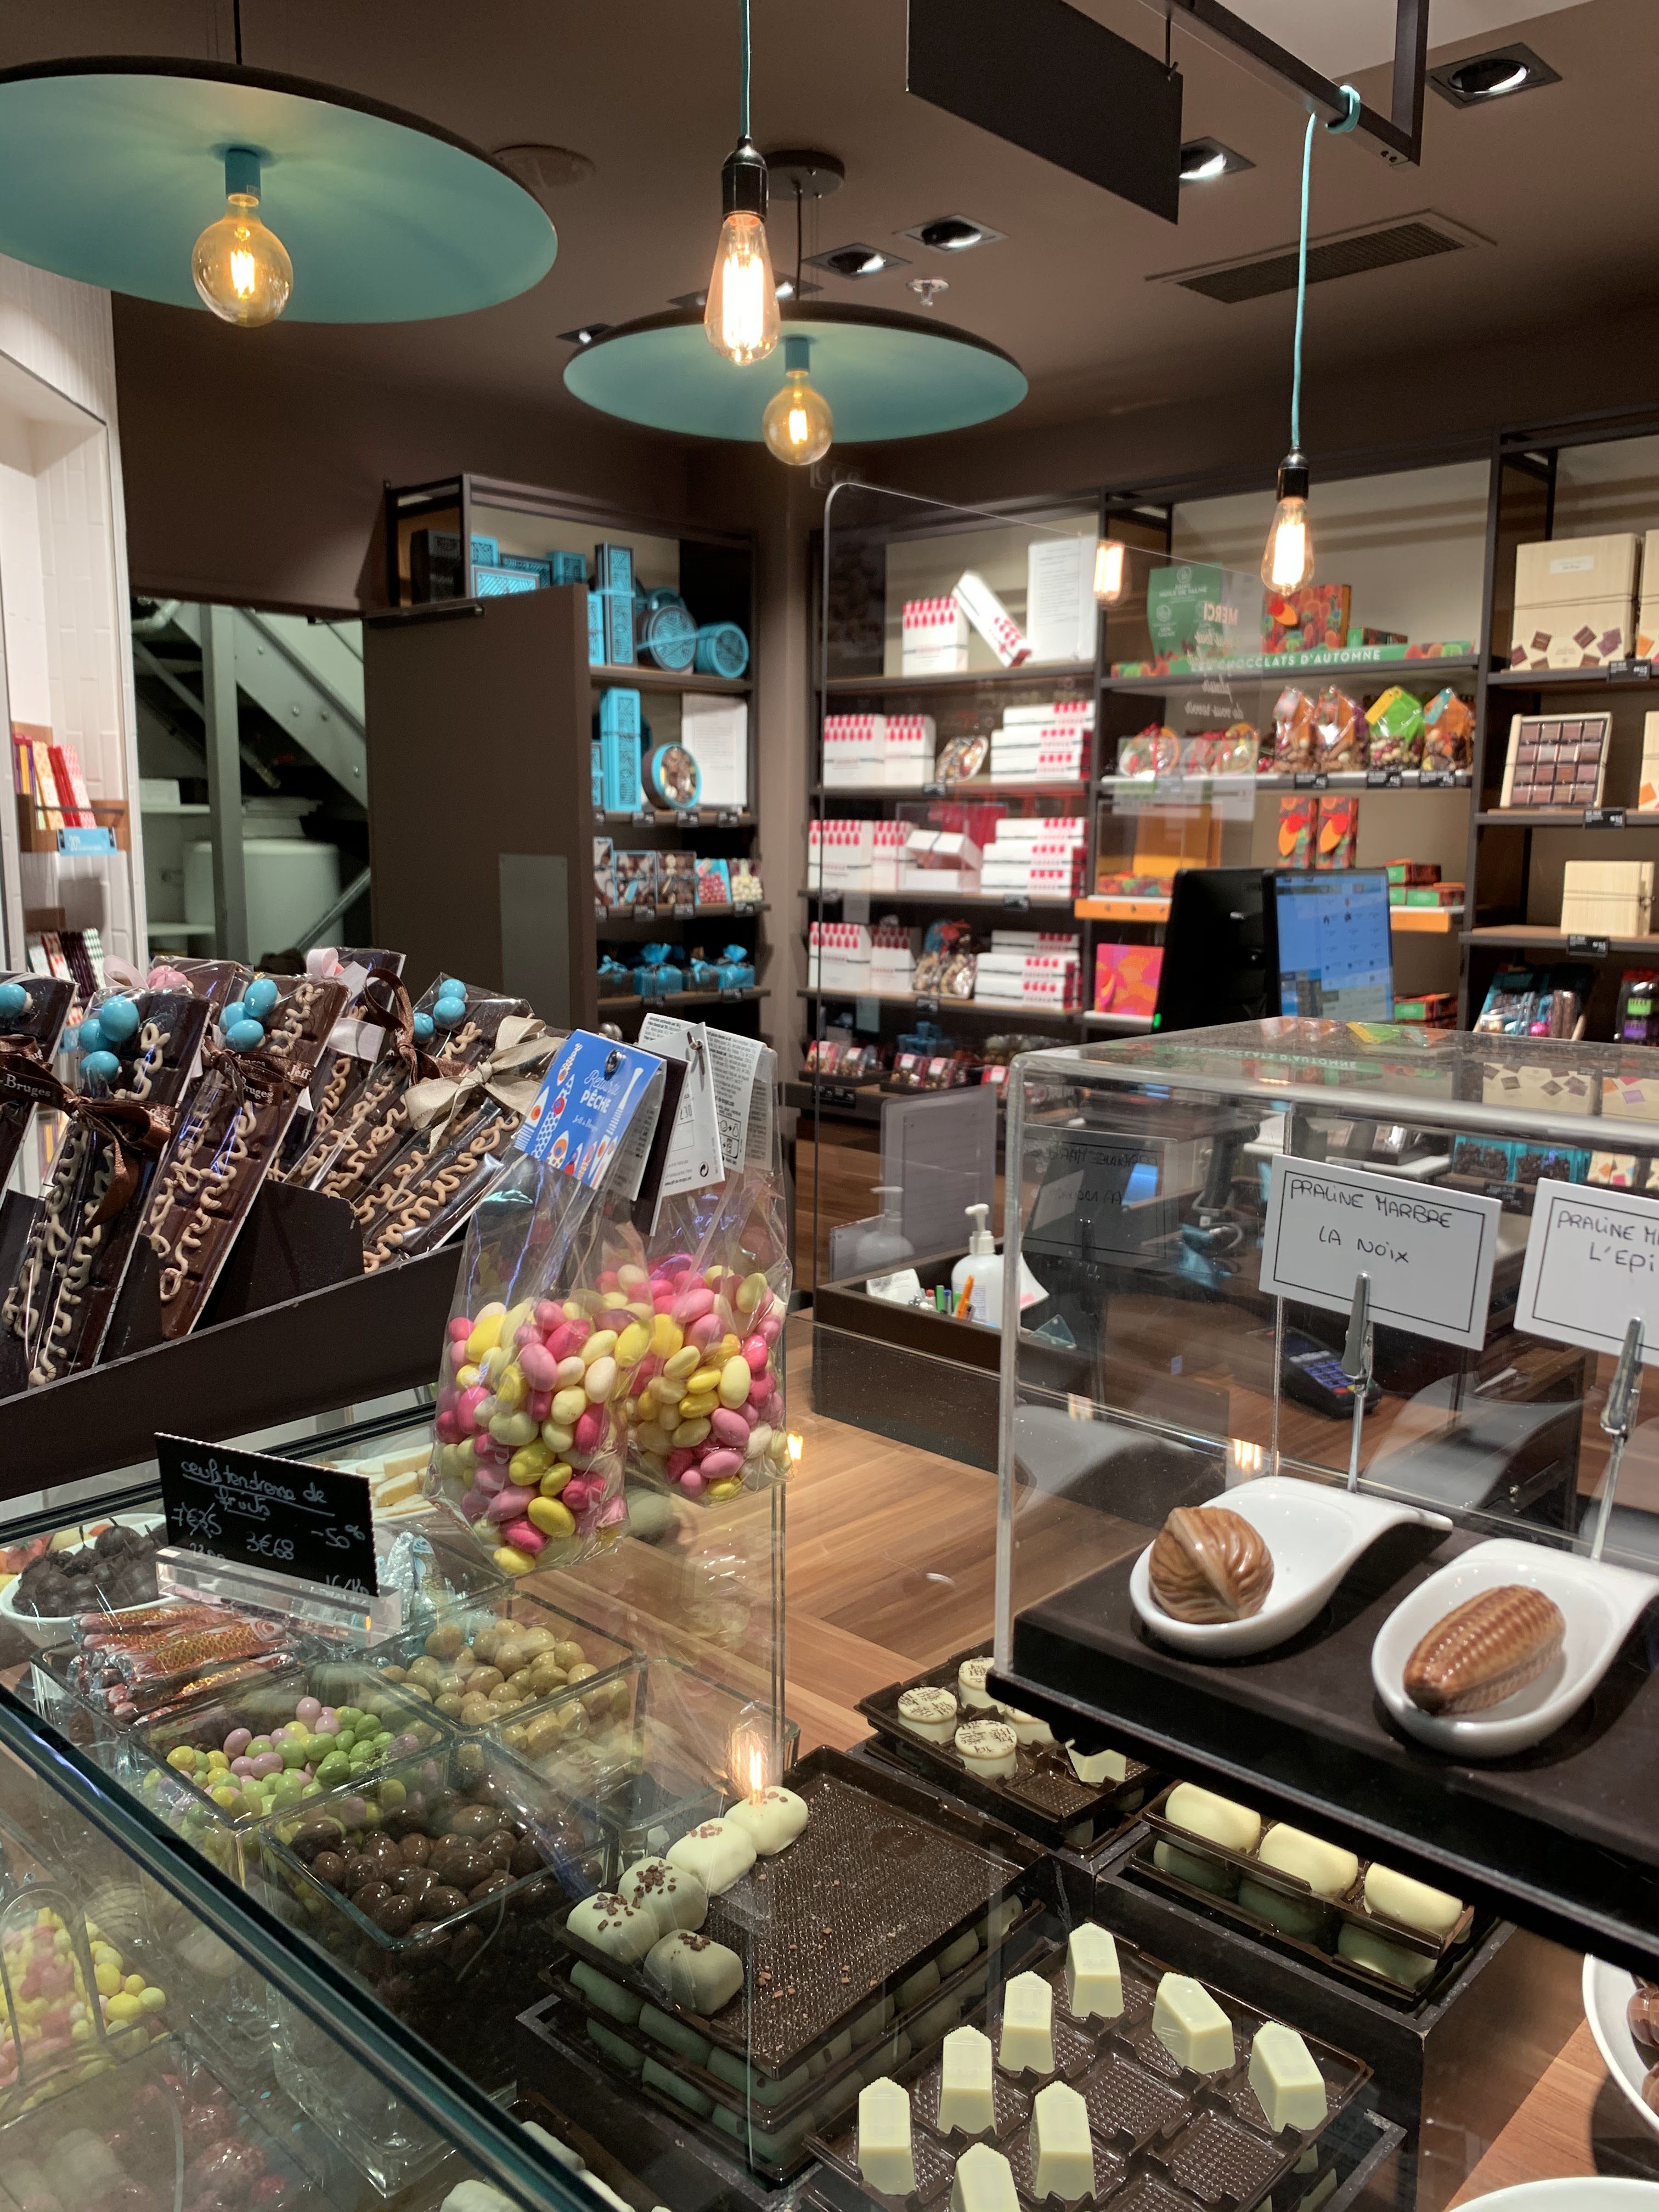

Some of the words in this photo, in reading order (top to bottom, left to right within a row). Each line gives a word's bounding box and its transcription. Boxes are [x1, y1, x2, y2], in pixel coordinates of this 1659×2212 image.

[1300, 650, 1381, 665] D'AUTOMNE
[287, 1064, 312, 1079] Jeff
[5, 1074, 51, 1097] Bruges
[579, 1088, 612, 1114] PÊCHE
[1319, 1225, 1341, 1246] LA
[302, 1481, 328, 1504] de
[246, 1531, 295, 1561] 3€68
